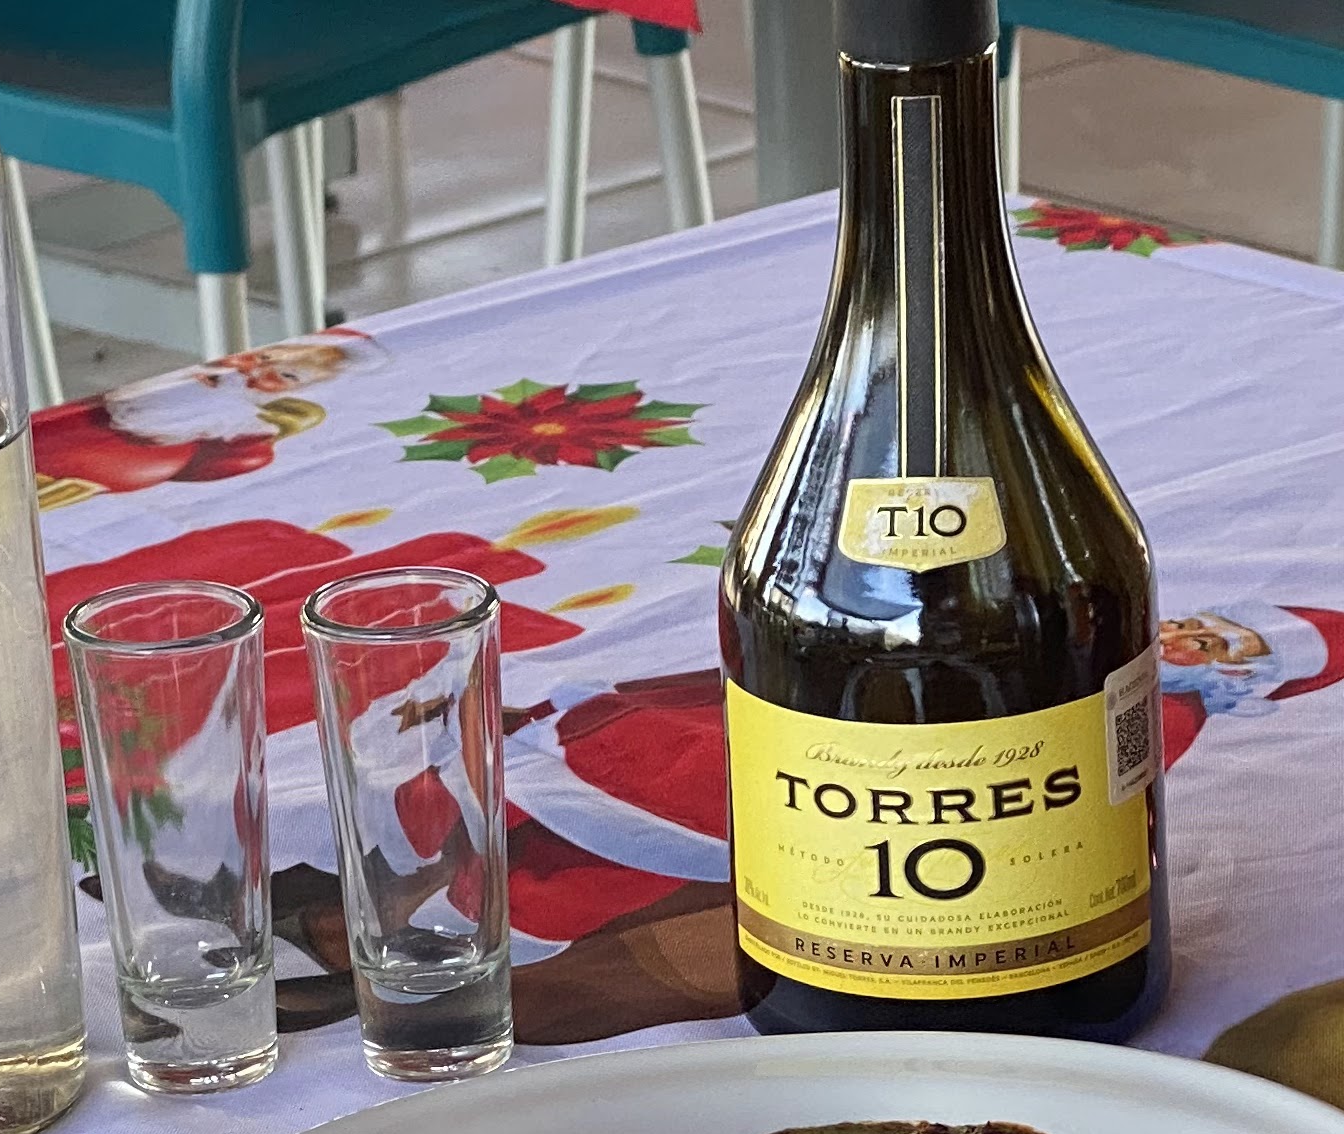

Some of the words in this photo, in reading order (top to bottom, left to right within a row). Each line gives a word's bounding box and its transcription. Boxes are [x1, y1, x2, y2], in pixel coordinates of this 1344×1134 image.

[877, 504, 967, 537] T10
[806, 742, 908, 779] Brandy
[915, 745, 987, 770] desde
[993, 740, 1045, 768] 1928
[776, 765, 1082, 825] TORRES
[864, 839, 986, 900] 10
[1009, 841, 1083, 866] SOLERA
[798, 911, 809, 921] LO
[814, 916, 877, 933] CONVIERTE
[884, 926, 899, 935] EN
[906, 926, 922, 935] UN
[930, 925, 980, 935] BRANDY
[987, 909, 1070, 932] EXCEPCIONAL
[802, 901, 835, 915] DESDE
[876, 914, 891, 922] SU
[897, 914, 971, 923] CUIDADOSA
[979, 899, 1062, 920] ELABORACIÓN
[795, 937, 914, 969] RESERVA
[935, 935, 1076, 969] IMPERIAL
